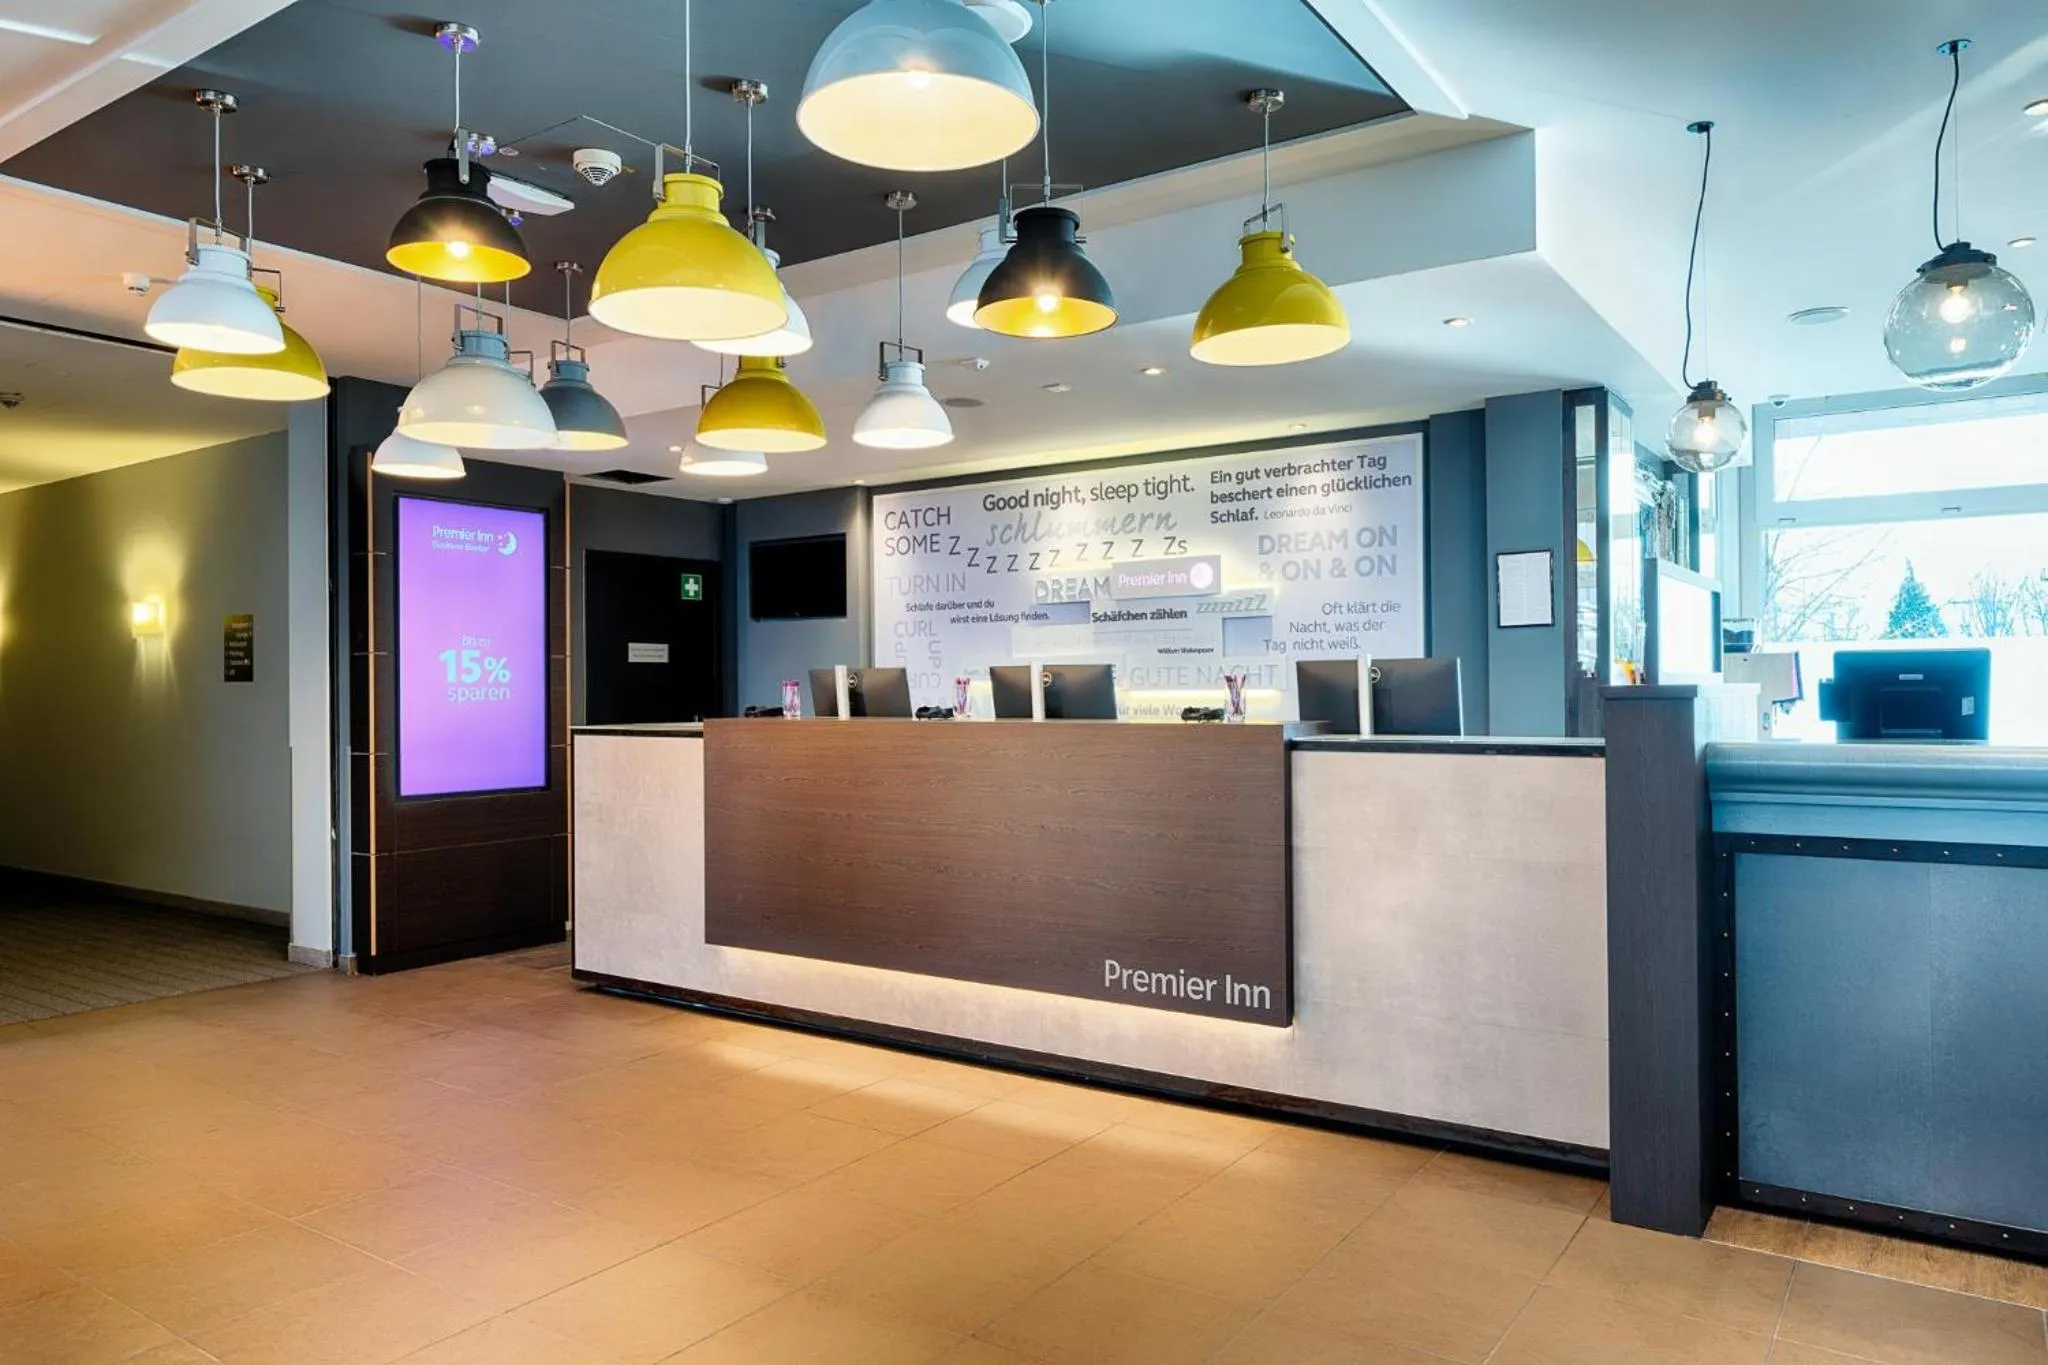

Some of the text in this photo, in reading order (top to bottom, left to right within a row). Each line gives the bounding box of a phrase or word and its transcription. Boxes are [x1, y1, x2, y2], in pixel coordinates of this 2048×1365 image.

[1210, 454, 1387, 485] Ein gut verbrachter Tag
[983, 474, 1195, 512] Good night, sleep tight.
[1210, 474, 1412, 504] beschert einen glücklichen
[884, 505, 951, 531] CATCH
[1210, 503, 1353, 524] Schlaf. Leonardo da Vinci
[477, 528, 494, 543] Inn
[885, 533, 941, 557] SOME
[1258, 525, 1398, 555] DREAM ON
[1119, 570, 1188, 588] Premier Inn
[1281, 558, 1321, 581] ON
[1329, 557, 1348, 579] &
[1354, 554, 1397, 577] ON
[885, 571, 966, 597] TURN IN
[1035, 575, 1112, 601] DREAM
[966, 600, 982, 610] und
[983, 598, 995, 609] du
[1321, 599, 1401, 615] Oft klärt die
[1091, 608, 1188, 624] Schäfchen zählen
[1289, 618, 1386, 634] Nacht, was der
[894, 619, 938, 639] CURL
[1263, 638, 1286, 653] Tag
[1292, 637, 1325, 651] nicht
[438, 648, 512, 684] 15%
[1129, 666, 1187, 688] GUTE
[448, 686, 511, 705] sparen
[1104, 959, 1271, 1010] Premier Inn
